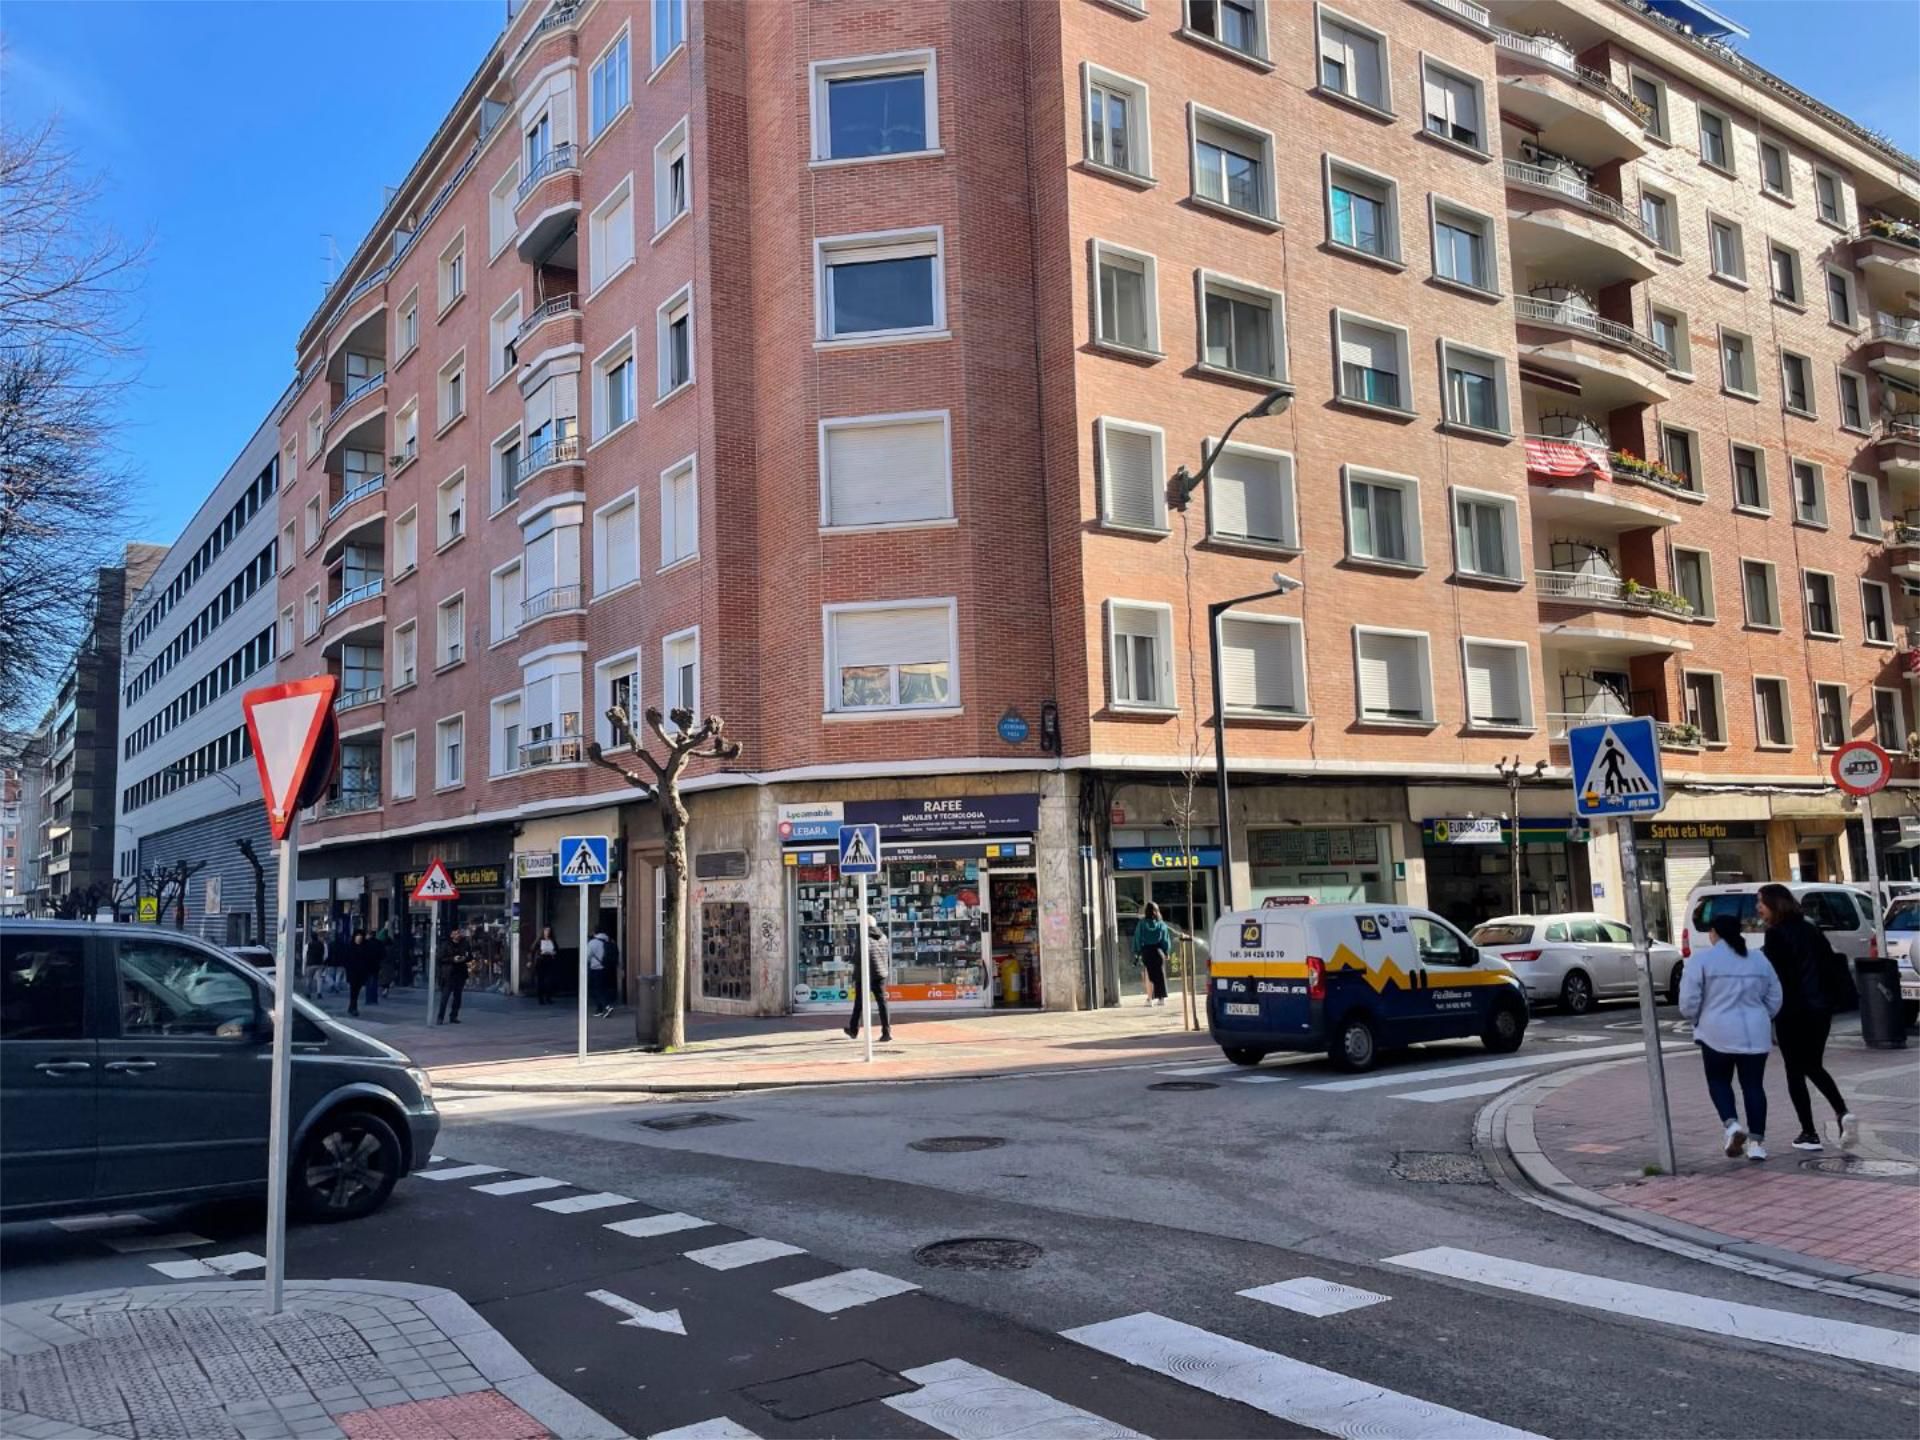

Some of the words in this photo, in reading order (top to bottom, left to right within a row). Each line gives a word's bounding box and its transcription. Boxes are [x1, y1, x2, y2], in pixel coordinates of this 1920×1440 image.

[923, 800, 963, 812] RAFEE
[792, 826, 828, 836] LEBARA
[1449, 822, 1500, 833] EUROMASTER
[1651, 823, 1680, 838] Sartu
[1681, 825, 1698, 838] eta
[1699, 823, 1727, 838] Hartu
[1243, 927, 1260, 941] 40
